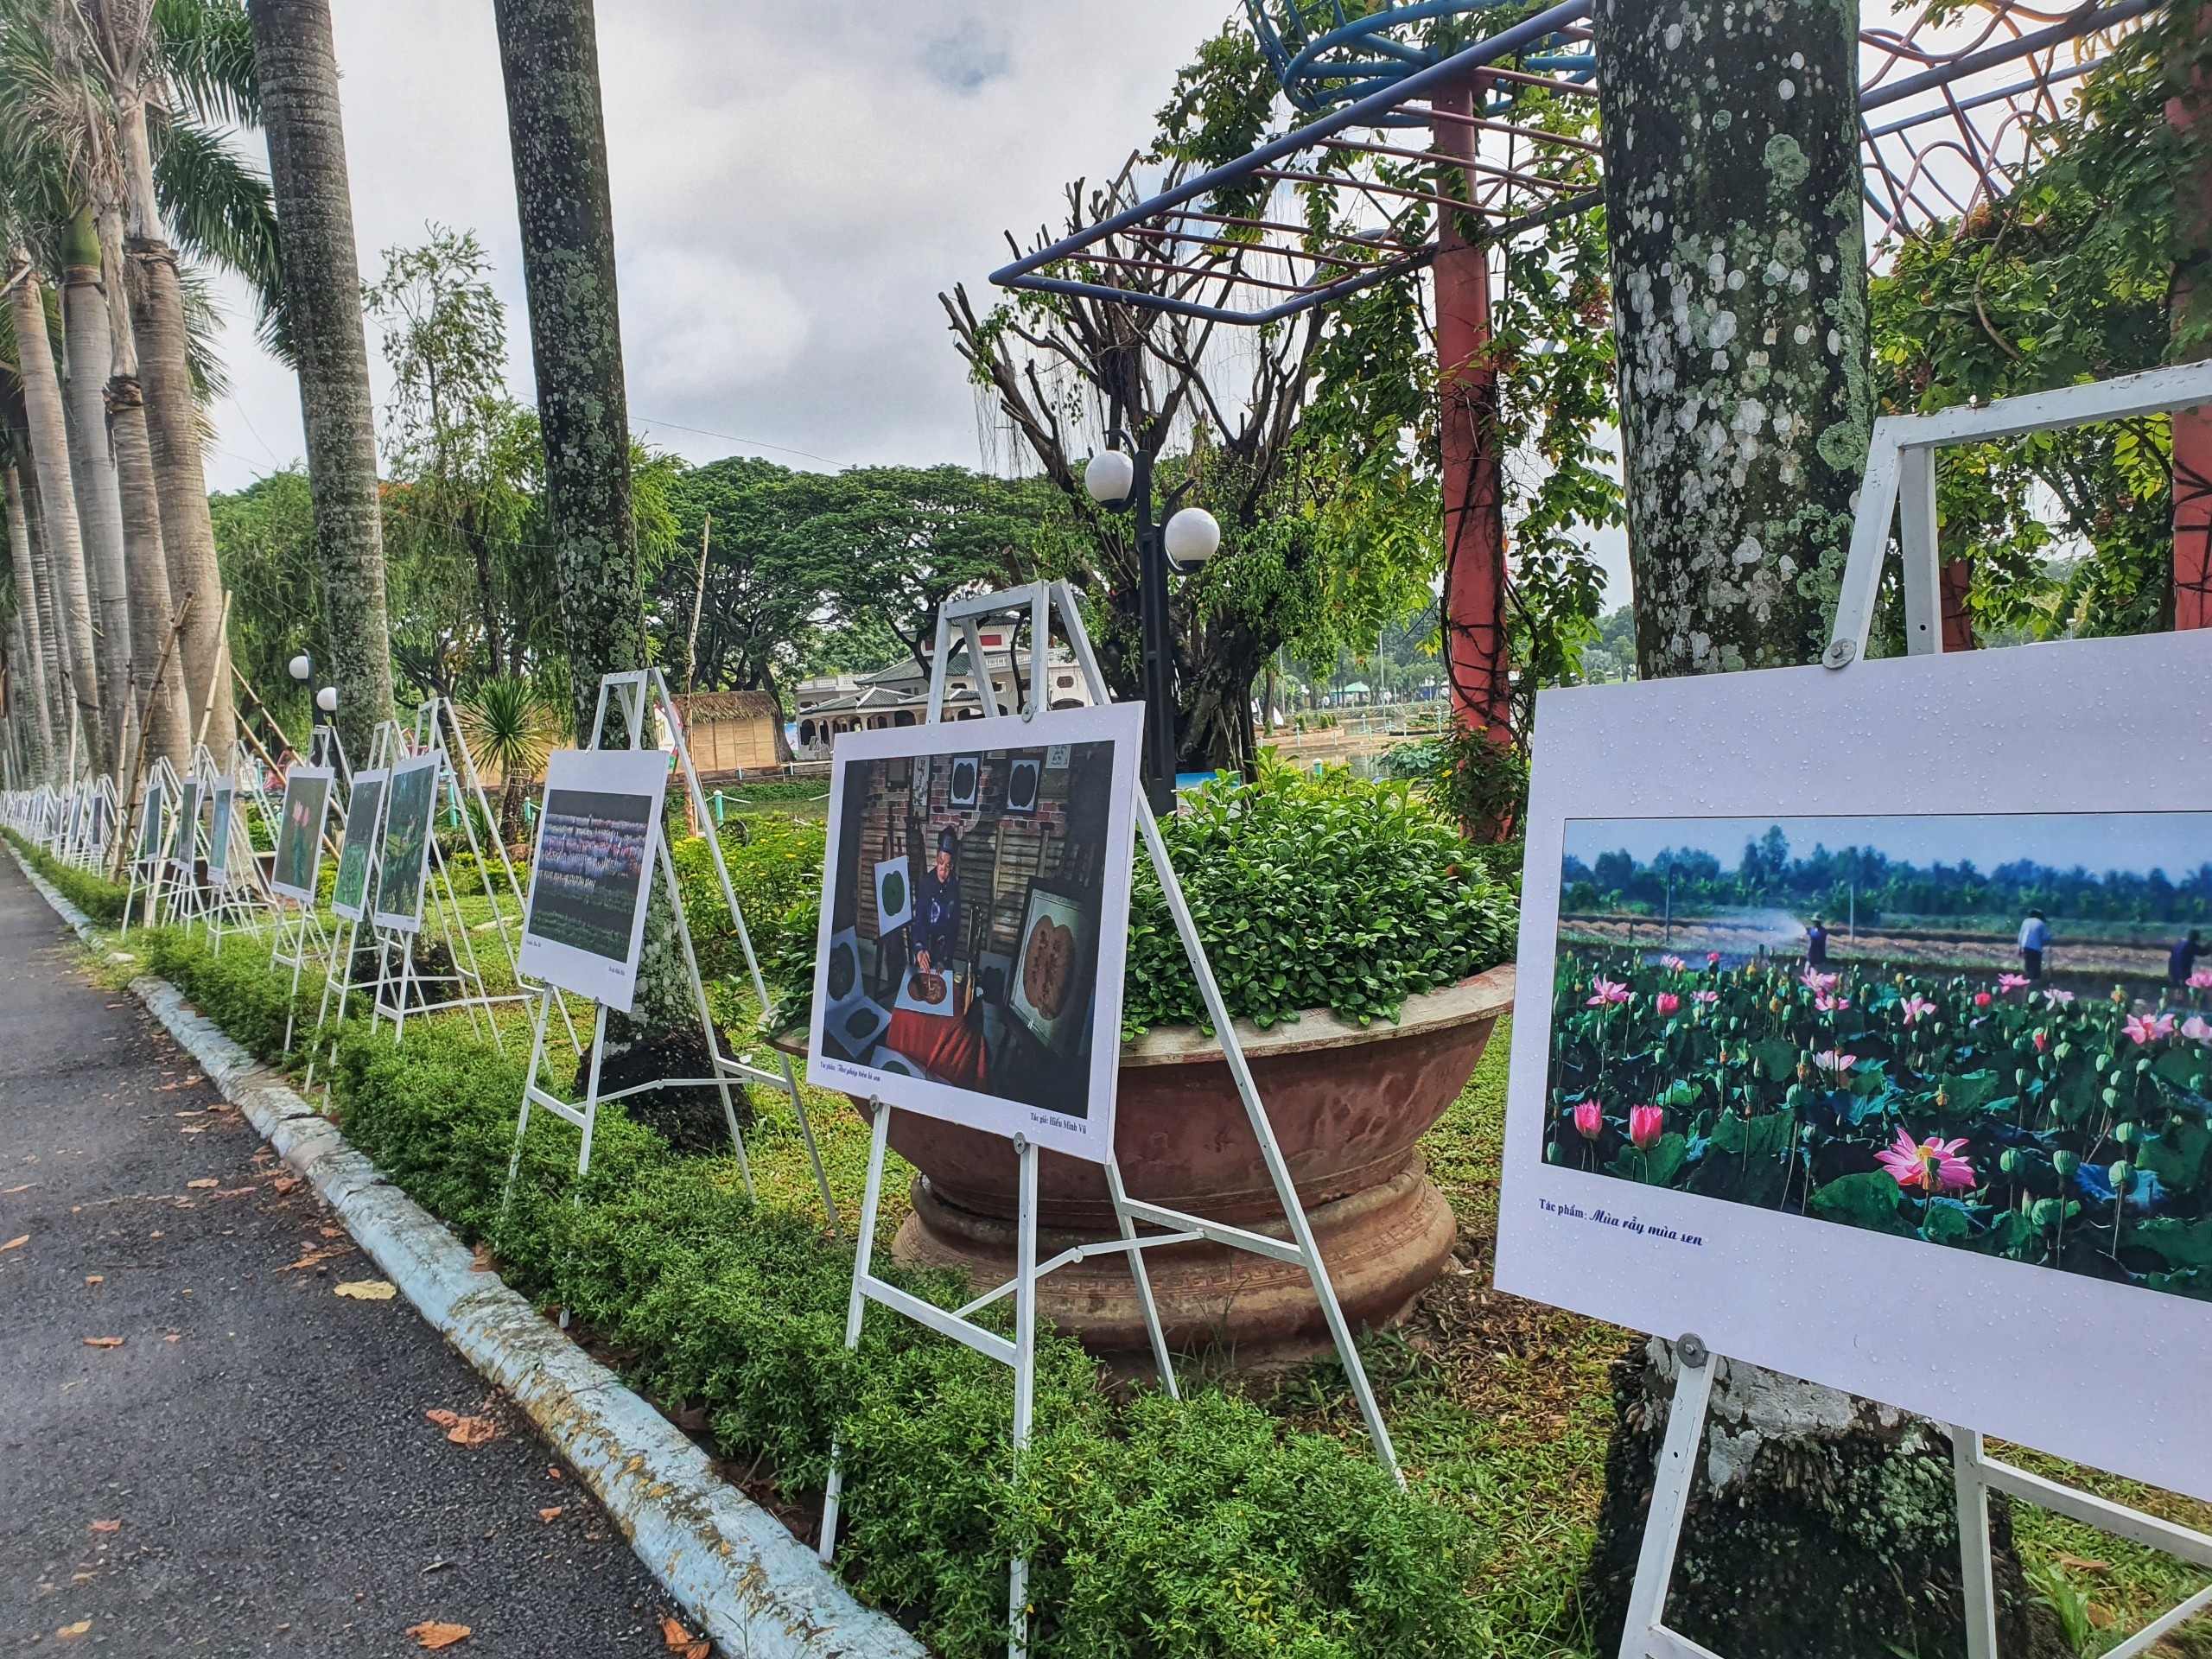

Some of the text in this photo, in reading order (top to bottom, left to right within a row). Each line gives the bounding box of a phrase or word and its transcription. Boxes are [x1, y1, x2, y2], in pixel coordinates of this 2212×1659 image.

[1030, 1112, 1039, 1122] Tác
[1063, 1120, 1077, 1132] Minh
[1539, 1198, 1703, 1246] Tác phẩm: Mùa rẫy mùa sen
